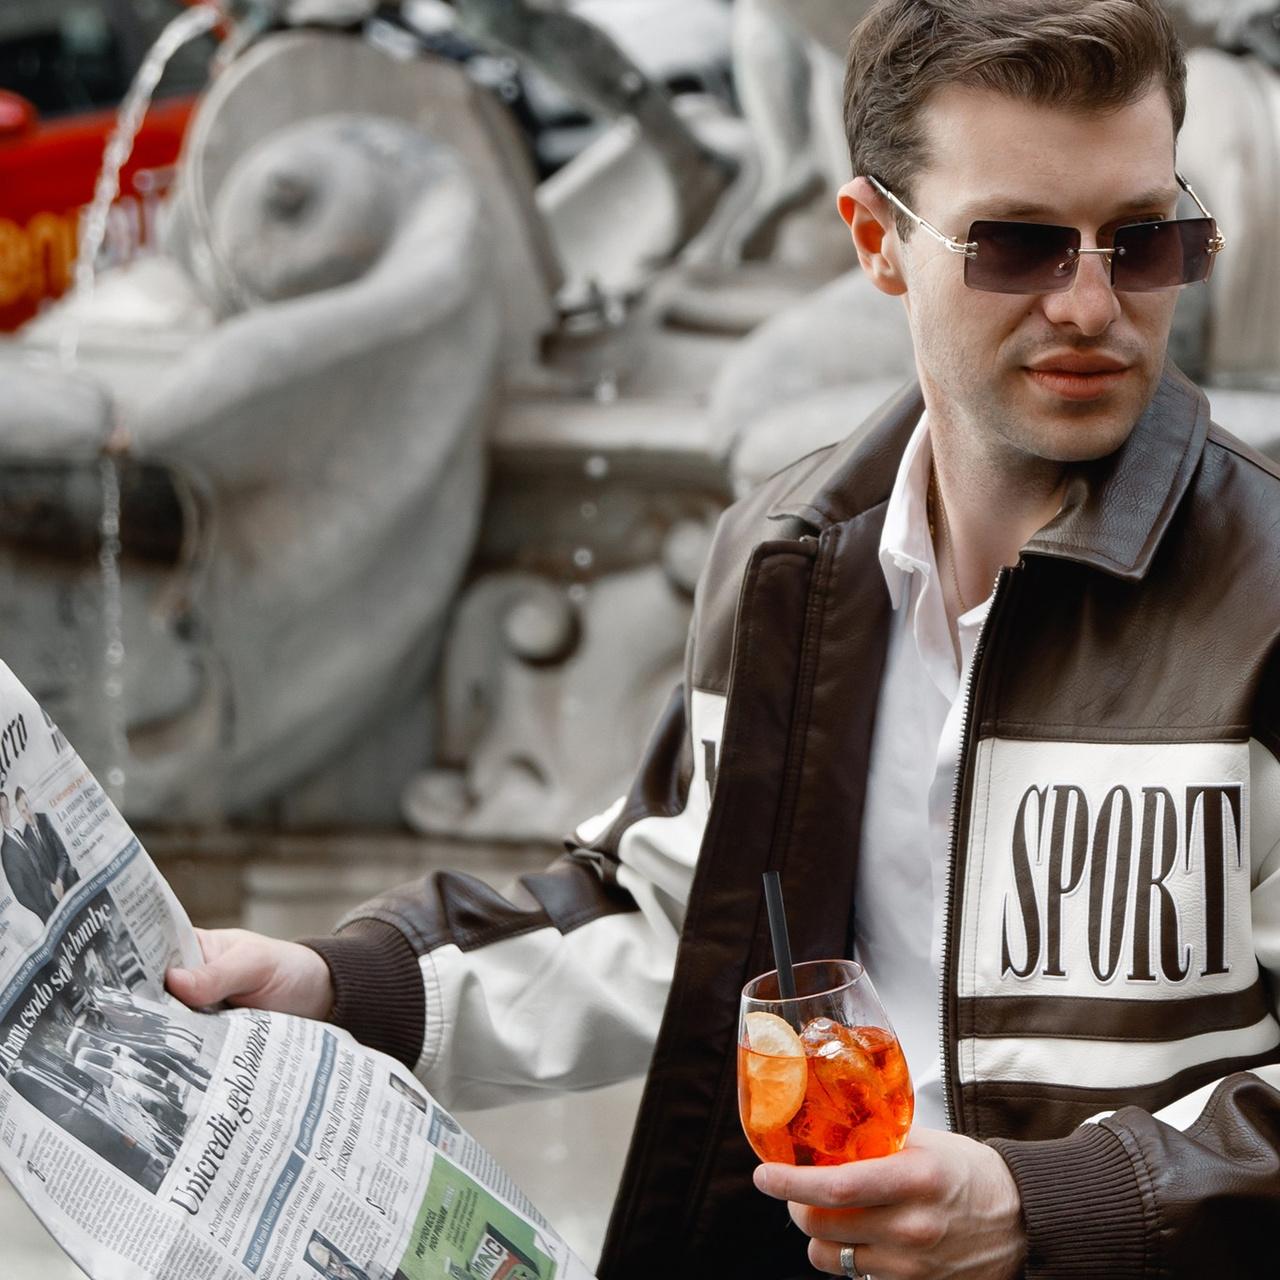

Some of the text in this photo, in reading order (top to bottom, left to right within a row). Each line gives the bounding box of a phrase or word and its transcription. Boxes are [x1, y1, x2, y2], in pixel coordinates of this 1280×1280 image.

[1000, 782, 1244, 986] SPORT
[20, 983, 53, 1028] esodo
[67, 903, 116, 953] bombe
[170, 1114, 239, 1215] Unicredit,
[223, 1074, 254, 1124] gelo
[314, 1123, 337, 1166] Sorpresa
[326, 1109, 341, 1127] al
[347, 1119, 360, 1139] non
[218, 1195, 231, 1214] non
[239, 1150, 251, 1167] sale
[245, 1140, 255, 1154] al
[275, 1169, 295, 1205] sindacati
[300, 1180, 309, 1193] al
[304, 1166, 317, 1185] mese
[230, 1187, 251, 1221] reazione
[292, 1190, 305, 1209] euro
[297, 1212, 308, 1229] per
[306, 1180, 325, 1212] contratti
[217, 1227, 233, 1248] Dura
[224, 1219, 236, 1230] la
